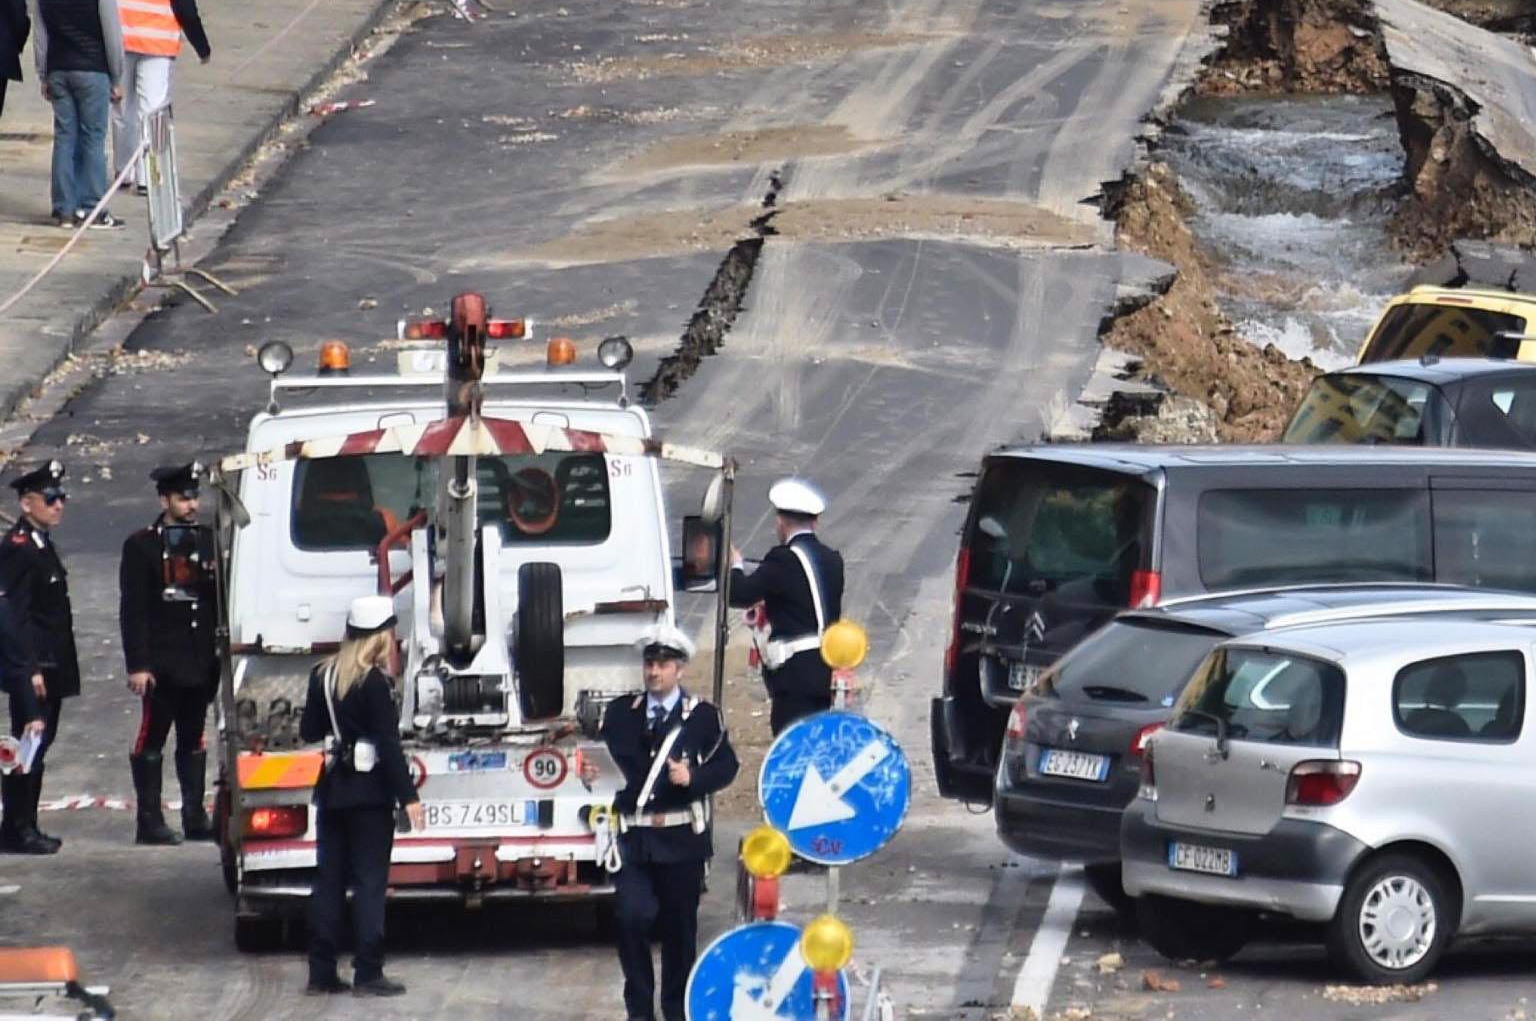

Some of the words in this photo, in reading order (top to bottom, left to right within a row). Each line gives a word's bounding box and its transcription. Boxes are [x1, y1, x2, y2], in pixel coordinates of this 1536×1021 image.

[534, 759, 556, 777] 90
[428, 805, 452, 826] BS
[461, 804, 522, 825] 749SL
